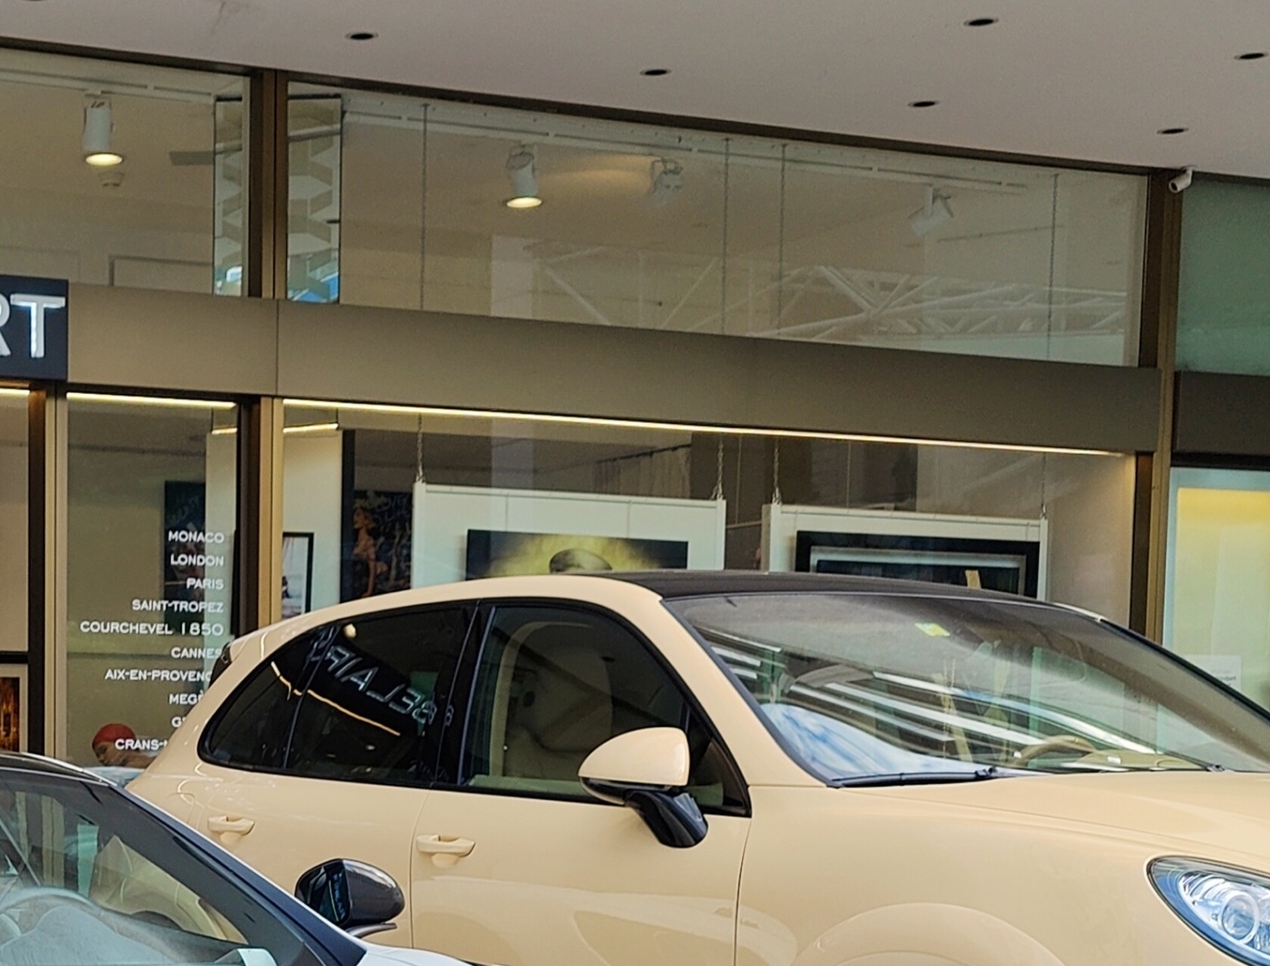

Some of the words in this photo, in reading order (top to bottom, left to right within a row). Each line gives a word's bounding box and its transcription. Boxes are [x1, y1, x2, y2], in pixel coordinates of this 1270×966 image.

[168, 530, 225, 543] MONACO
[170, 553, 224, 567] LONDON
[186, 577, 224, 590] PARIS
[132, 599, 224, 613] SAINT-TROPEZ
[80, 621, 173, 635] COURCHEVEL
[181, 622, 224, 636] 1850
[171, 647, 223, 659] CANNES
[114, 738, 168, 751] CRANS-
